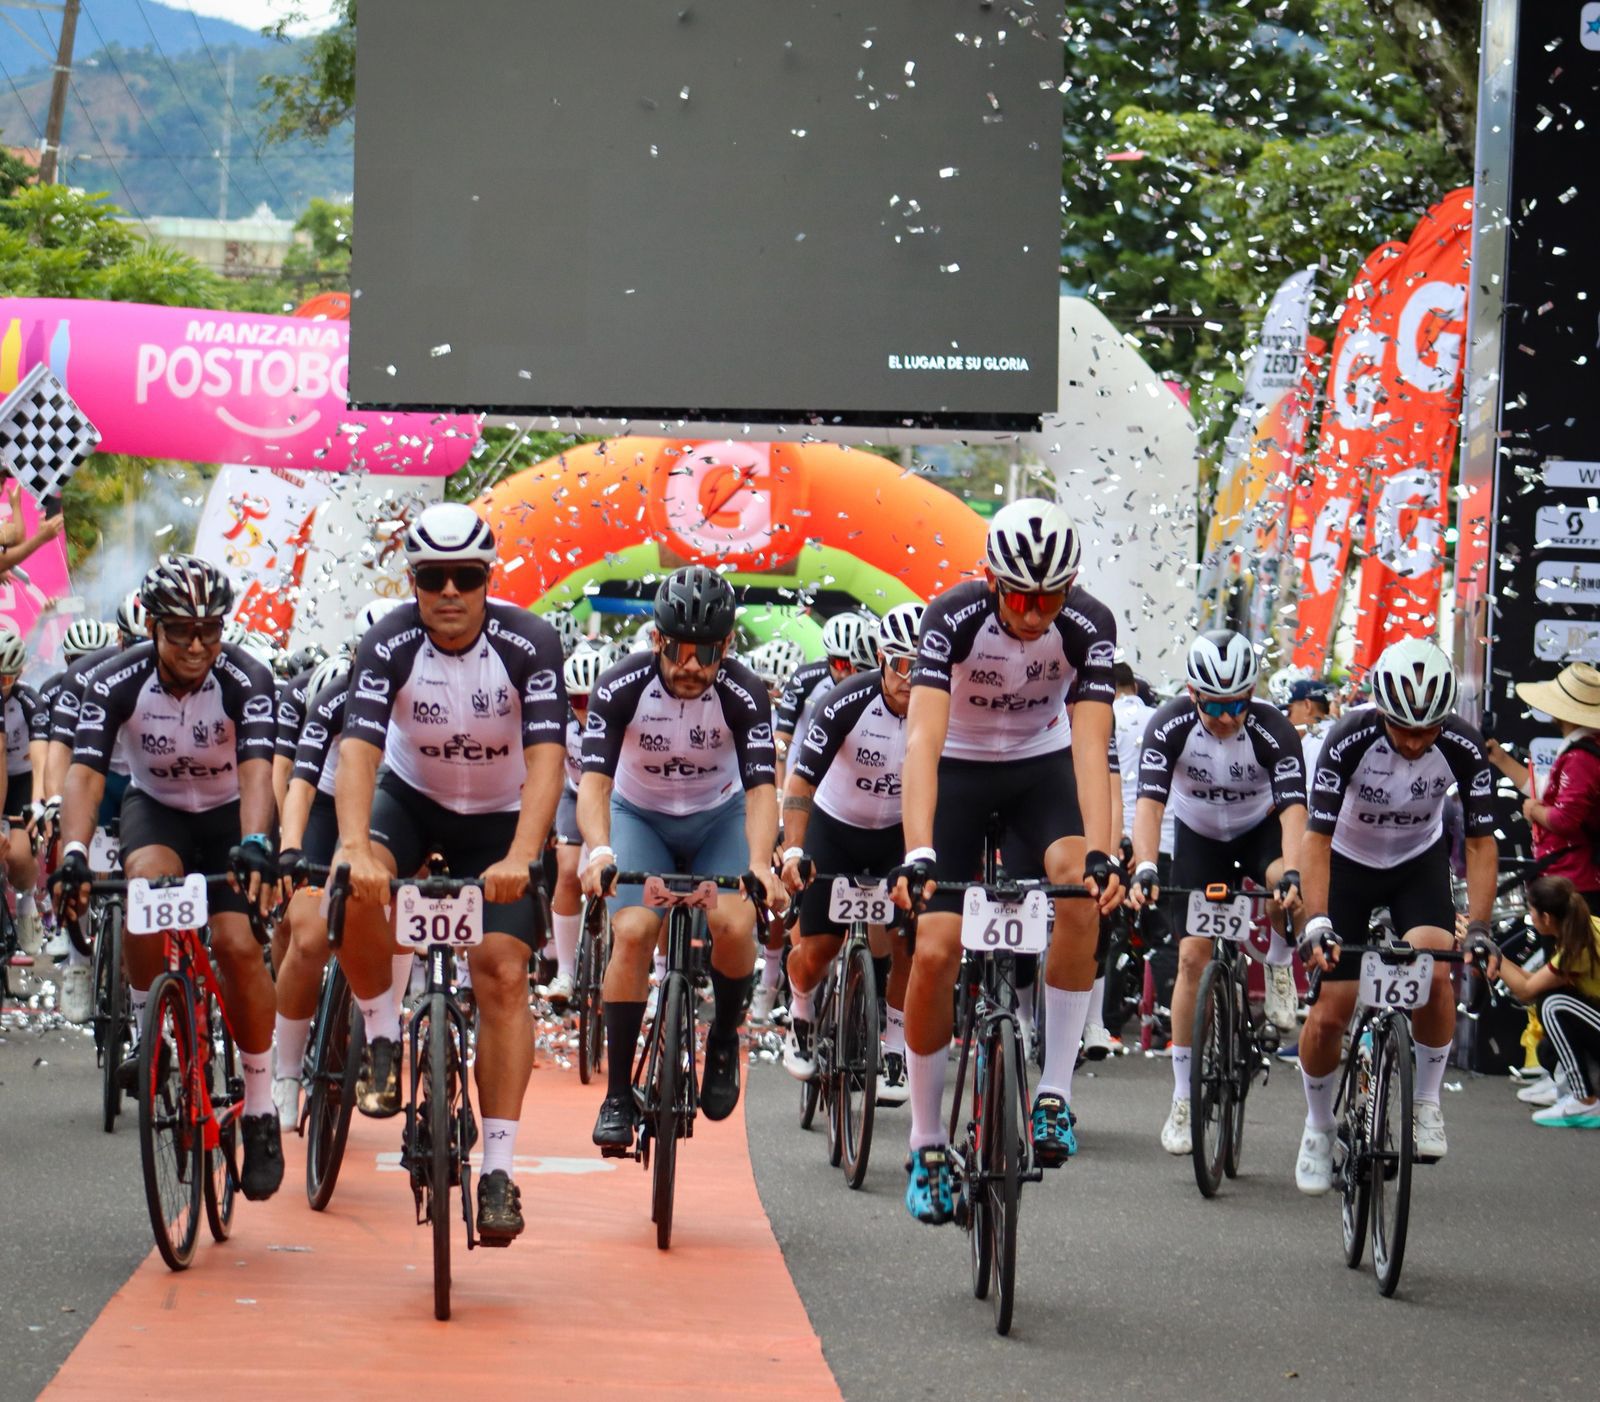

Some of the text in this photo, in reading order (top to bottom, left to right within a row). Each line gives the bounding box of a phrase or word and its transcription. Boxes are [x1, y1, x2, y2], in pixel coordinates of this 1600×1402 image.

[185, 319, 340, 347] MANZANA
[1397, 281, 1469, 392] G
[888, 354, 1030, 371] EL LUGAR DE SU GLORIA
[665, 440, 772, 554] G
[1551, 537, 1599, 546] SCOTT
[1061, 606, 1098, 634] SCOTT
[106, 658, 149, 689] SCOTT
[608, 665, 652, 693] SCOTT
[799, 668, 827, 680] SCOTT
[723, 677, 757, 711] SCOTT
[833, 685, 874, 713] SCOTT
[413, 714, 449, 724] HUEVOS
[528, 720, 561, 731] CasaToro
[1162, 711, 1195, 735] SCOTT
[419, 744, 509, 761] GFCM
[1337, 725, 1377, 753] SCOTT
[1359, 811, 1431, 826] GFCM
[142, 901, 195, 929] 188
[838, 899, 886, 920] 238
[409, 914, 472, 942] 306
[983, 918, 1023, 947] 60
[1196, 913, 1242, 937] 259
[1373, 978, 1420, 1005] 163
